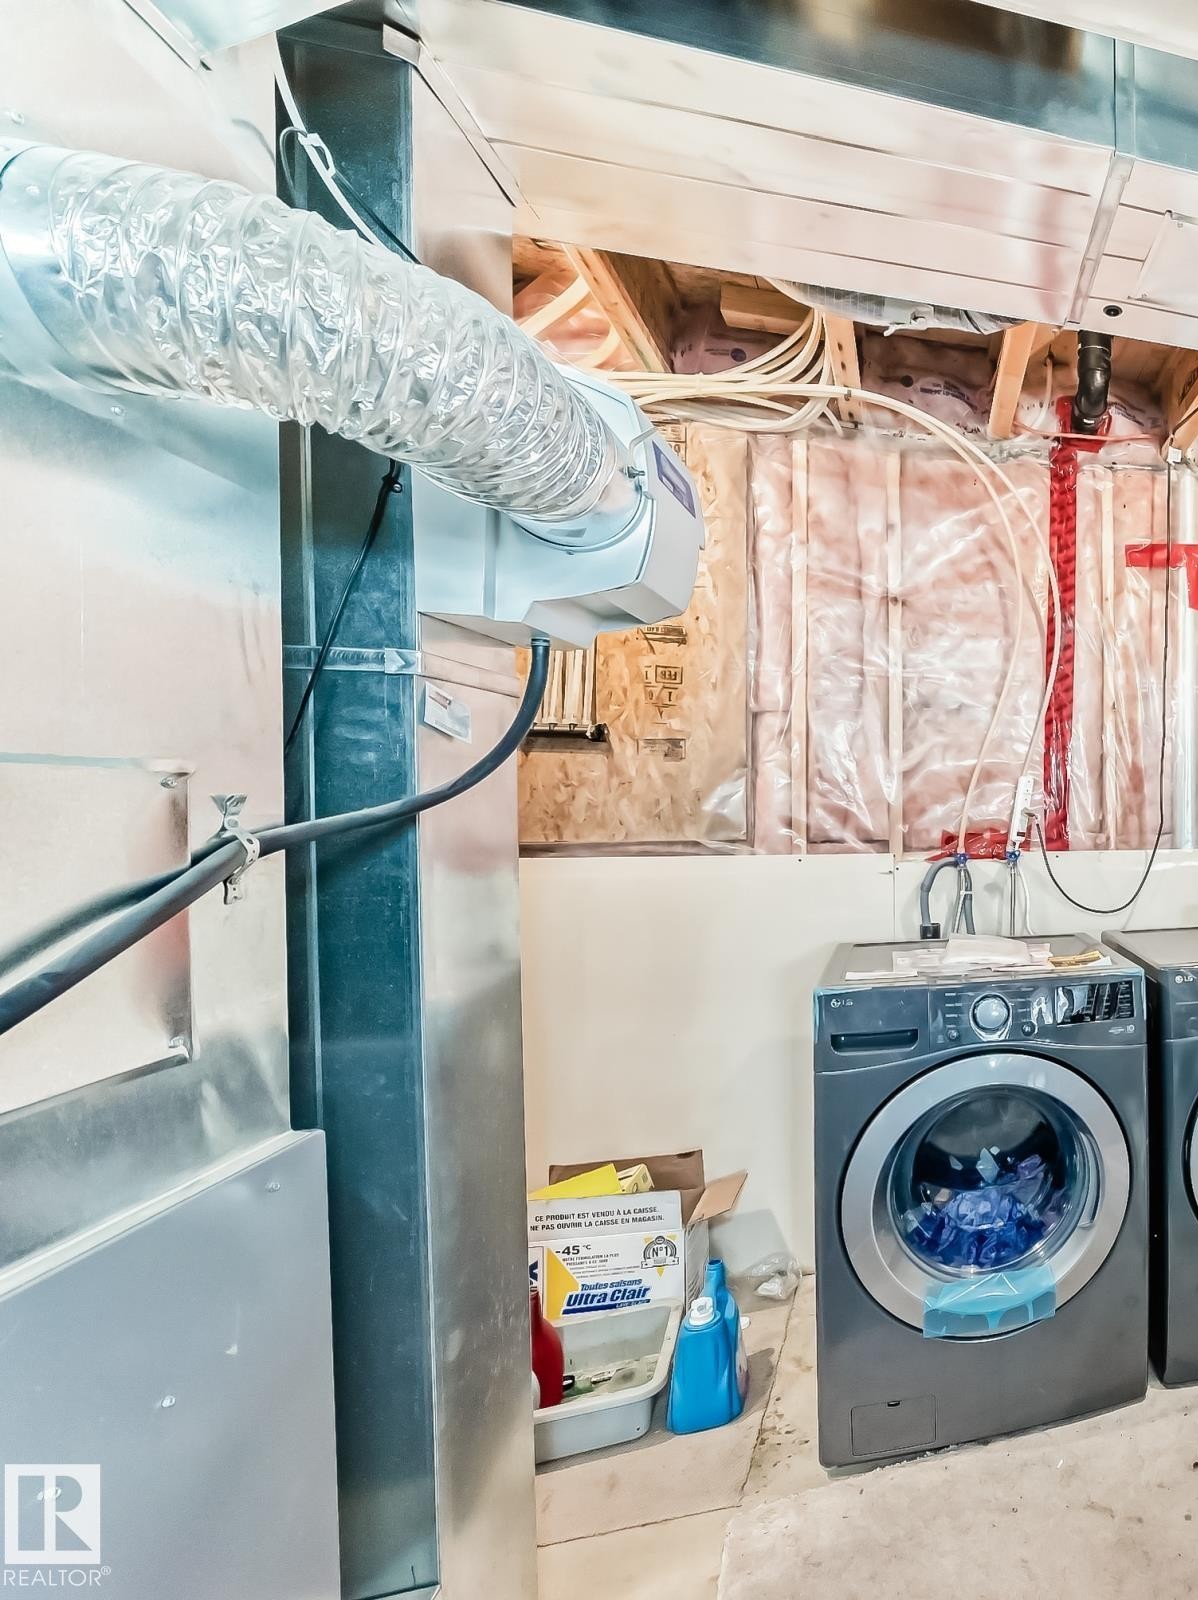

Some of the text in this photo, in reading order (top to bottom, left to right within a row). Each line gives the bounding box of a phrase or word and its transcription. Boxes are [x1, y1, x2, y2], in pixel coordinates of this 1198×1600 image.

[545, 1213, 576, 1222] PRODUIT
[591, 1210, 615, 1218] VENDU
[631, 1214, 665, 1223] MAGASIN.
[581, 1278, 643, 1291] Toutes saisons
[566, 1292, 608, 1307] Ultra
[609, 1286, 651, 1302] Clair
